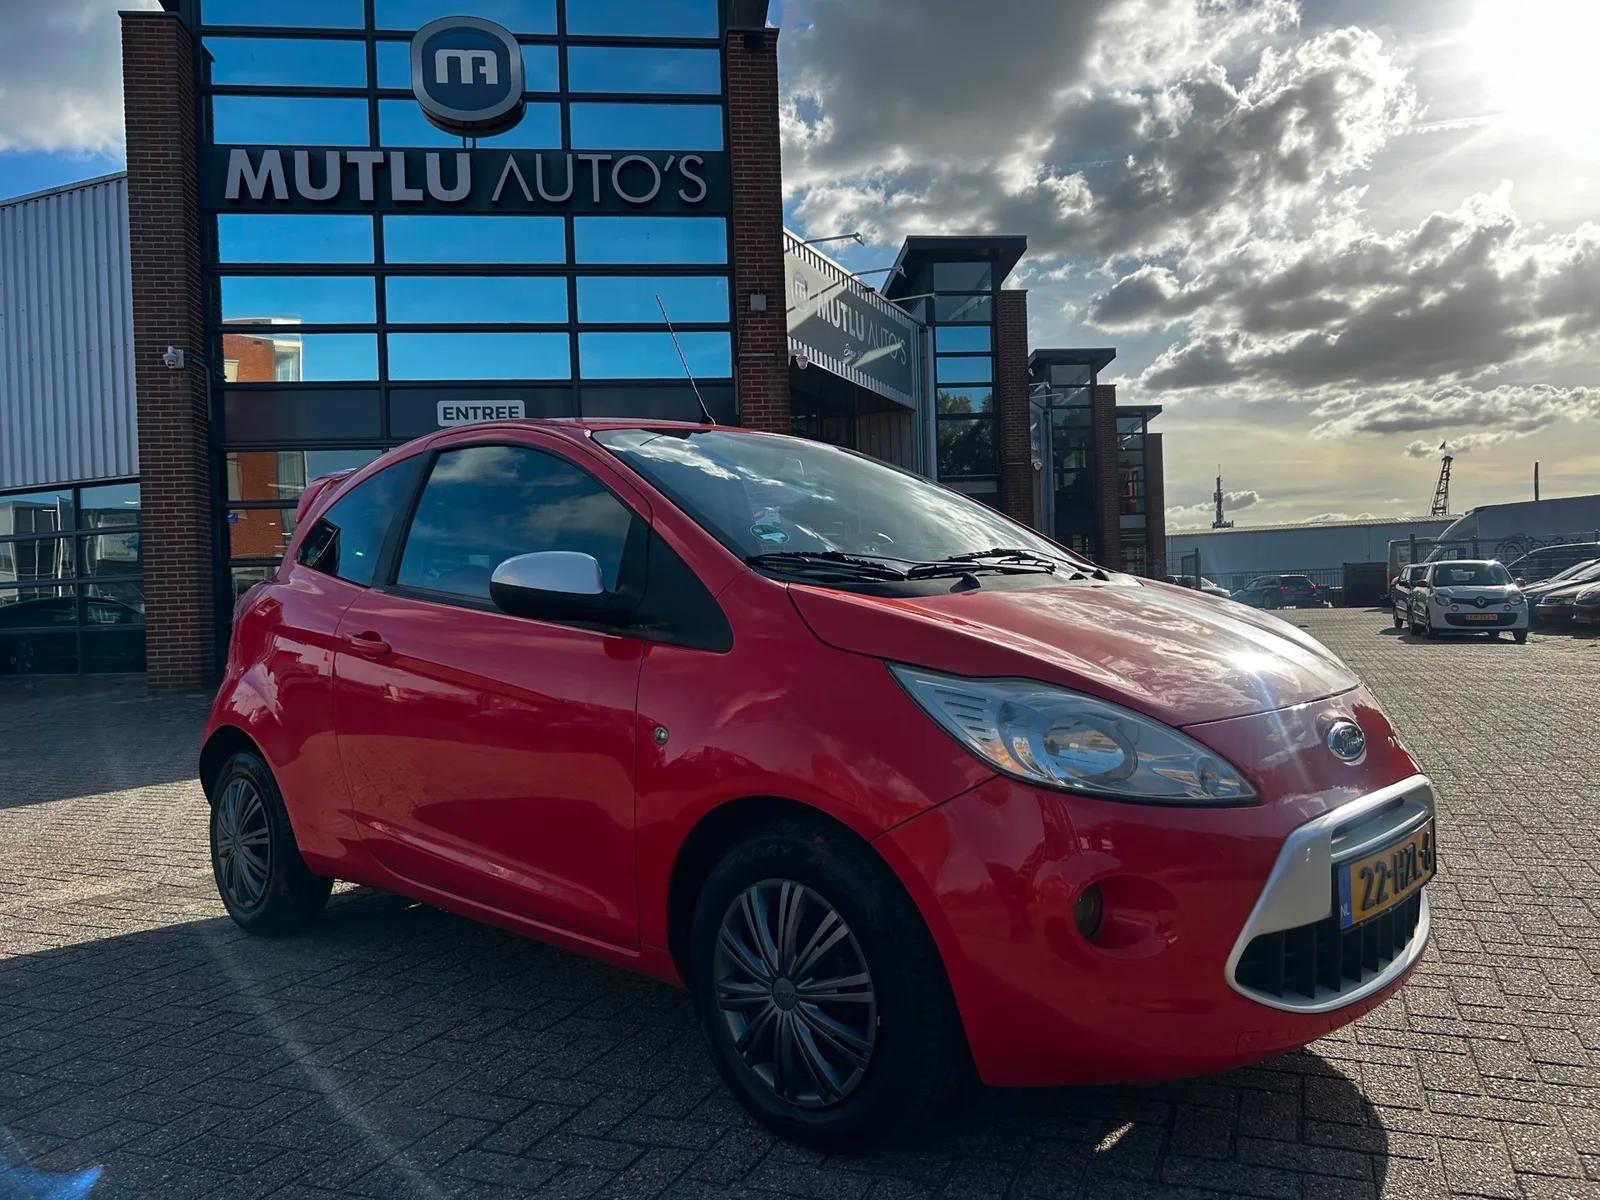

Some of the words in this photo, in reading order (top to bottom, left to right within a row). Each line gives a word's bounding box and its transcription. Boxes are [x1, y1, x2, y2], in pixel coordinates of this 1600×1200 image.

[225, 148, 472, 202] MUTLU
[491, 152, 708, 203] AUTO'S
[817, 288, 865, 341] MUTLU
[867, 320, 907, 366] AUTO'S
[442, 406, 519, 420] ENTREE
[1340, 902, 1351, 918] NL
